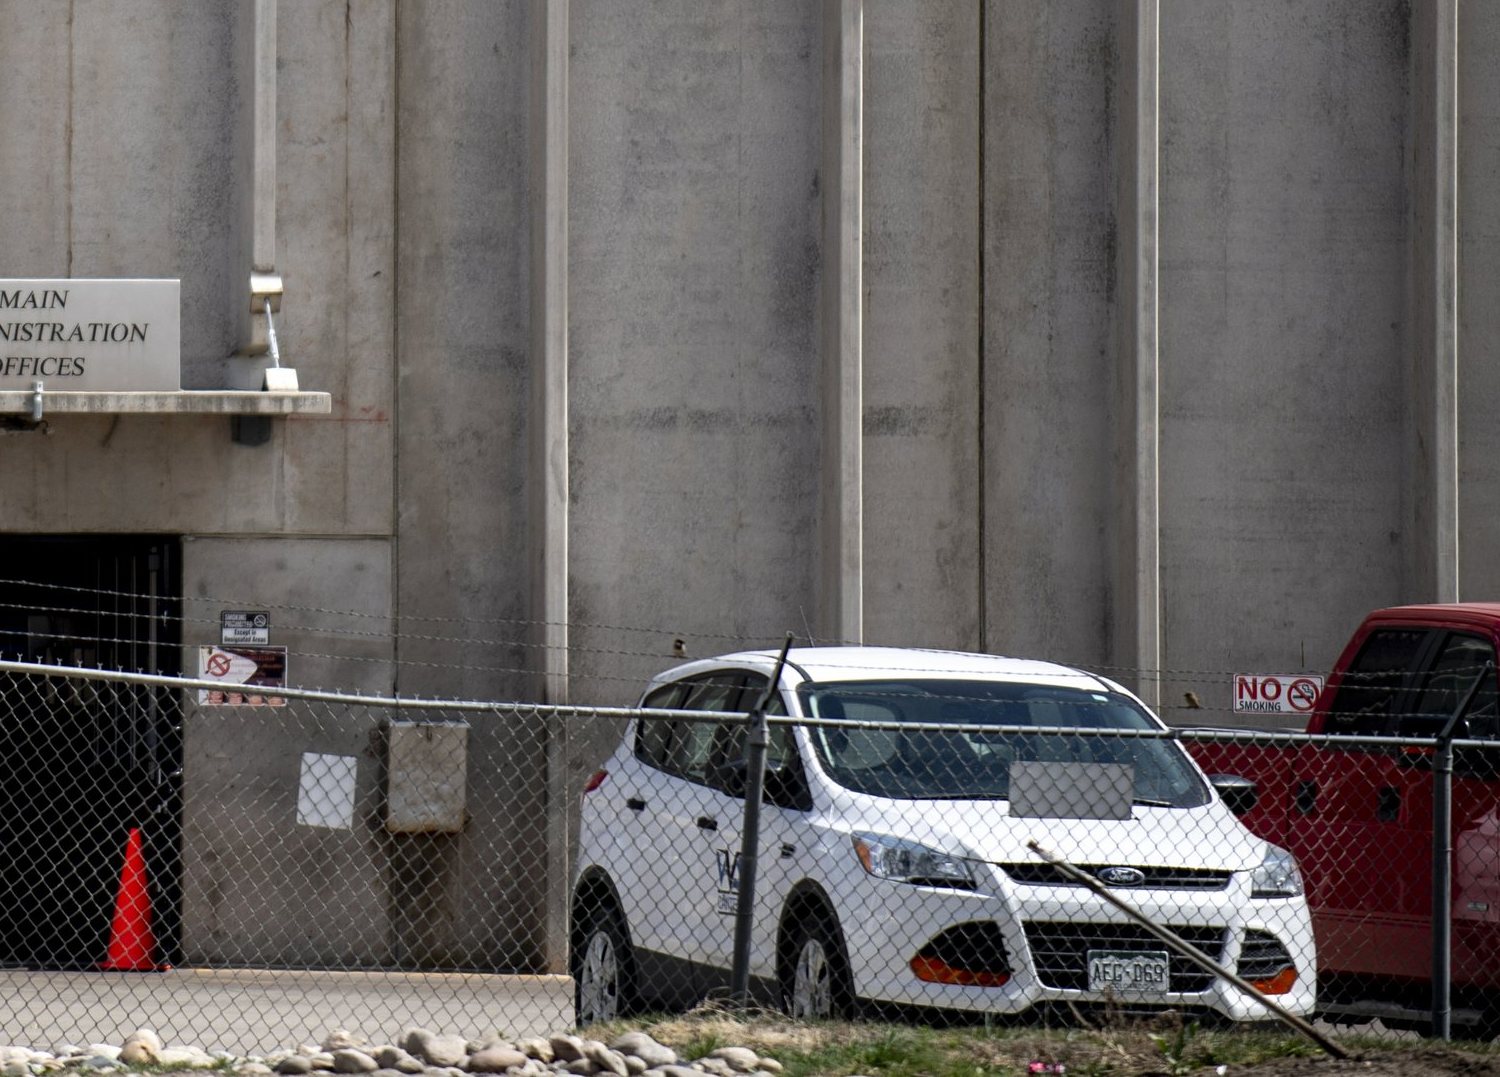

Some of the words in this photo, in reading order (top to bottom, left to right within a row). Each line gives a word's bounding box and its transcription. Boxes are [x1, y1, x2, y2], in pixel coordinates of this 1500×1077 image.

[1238, 677, 1282, 701] NO
[1239, 700, 1281, 712] SMOKING
[1108, 869, 1135, 881] Ford
